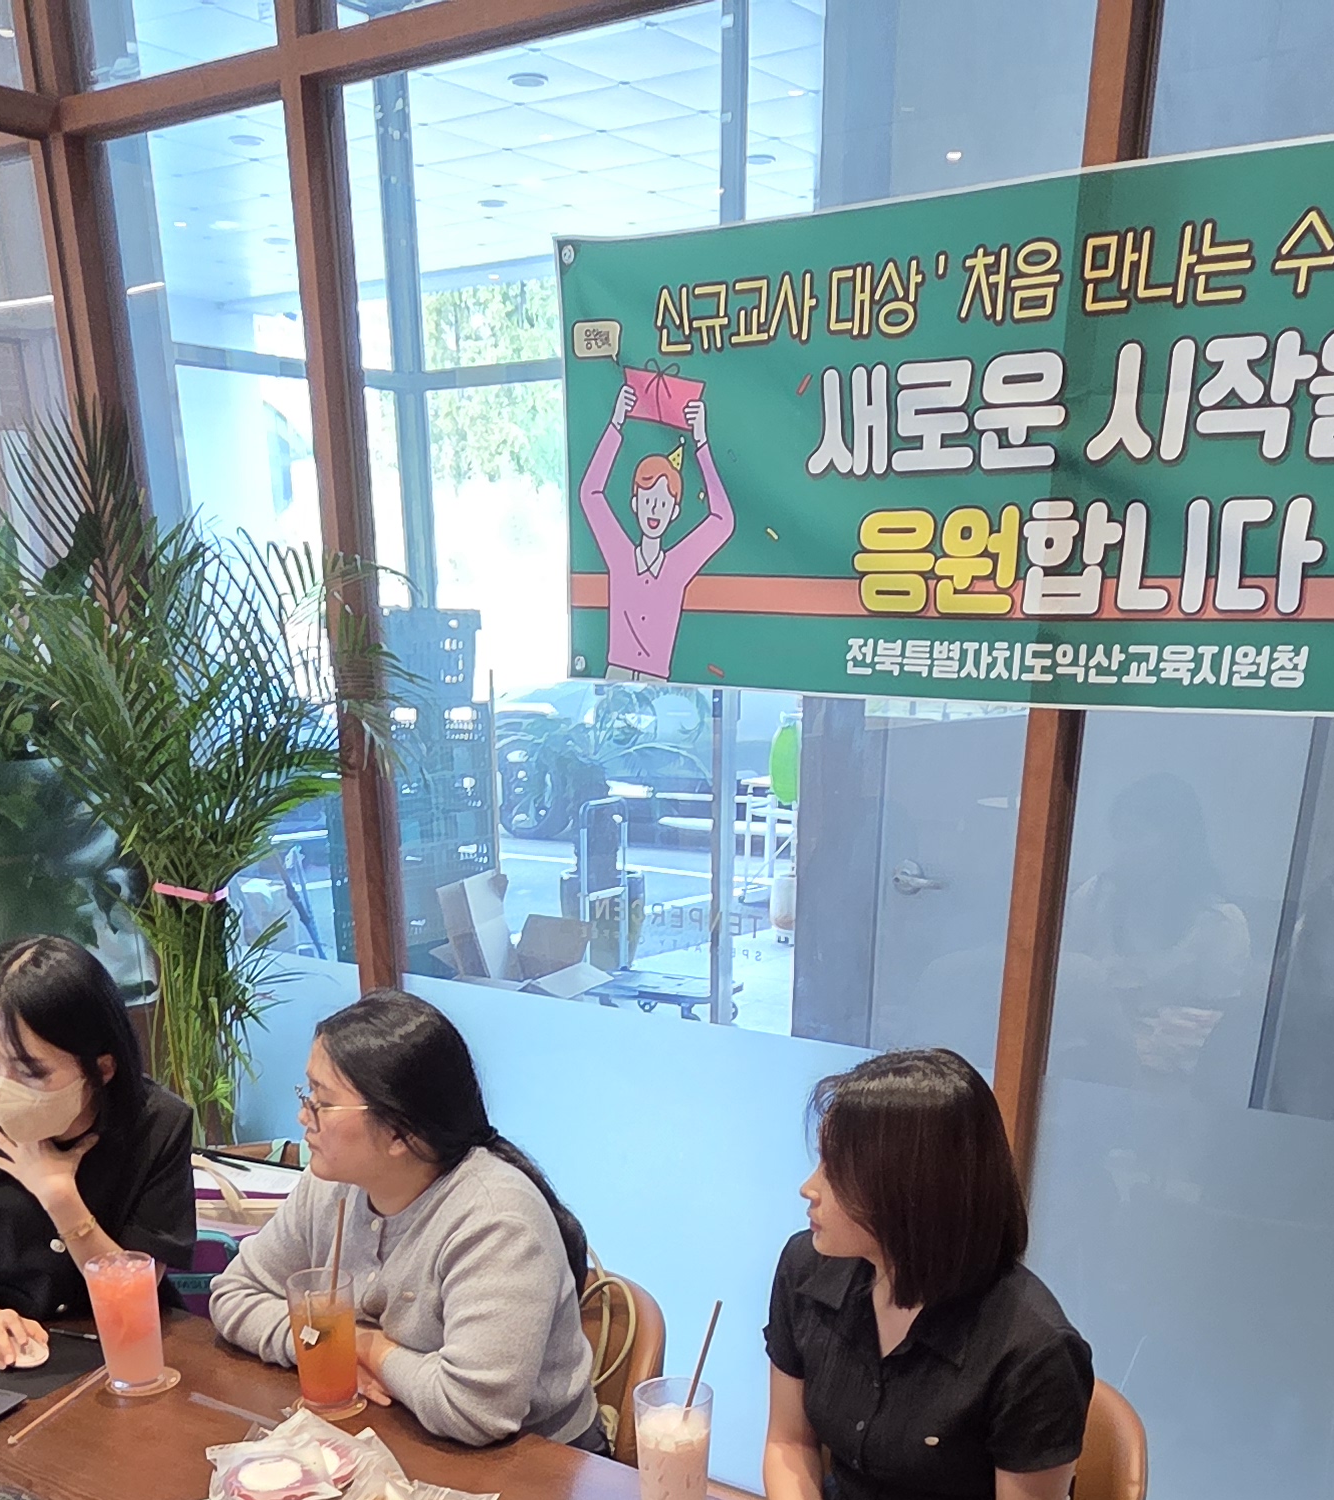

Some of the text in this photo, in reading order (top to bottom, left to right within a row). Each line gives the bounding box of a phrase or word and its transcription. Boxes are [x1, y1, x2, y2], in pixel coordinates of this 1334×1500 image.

[655, 271, 818, 354] 신규교사
[1082, 221, 1255, 315] 만나는
[806, 350, 1066, 477] 새로운
[853, 499, 1325, 615] 응원합니다
[845, 636, 1310, 688] 전북특별자치도익산교육지원청
